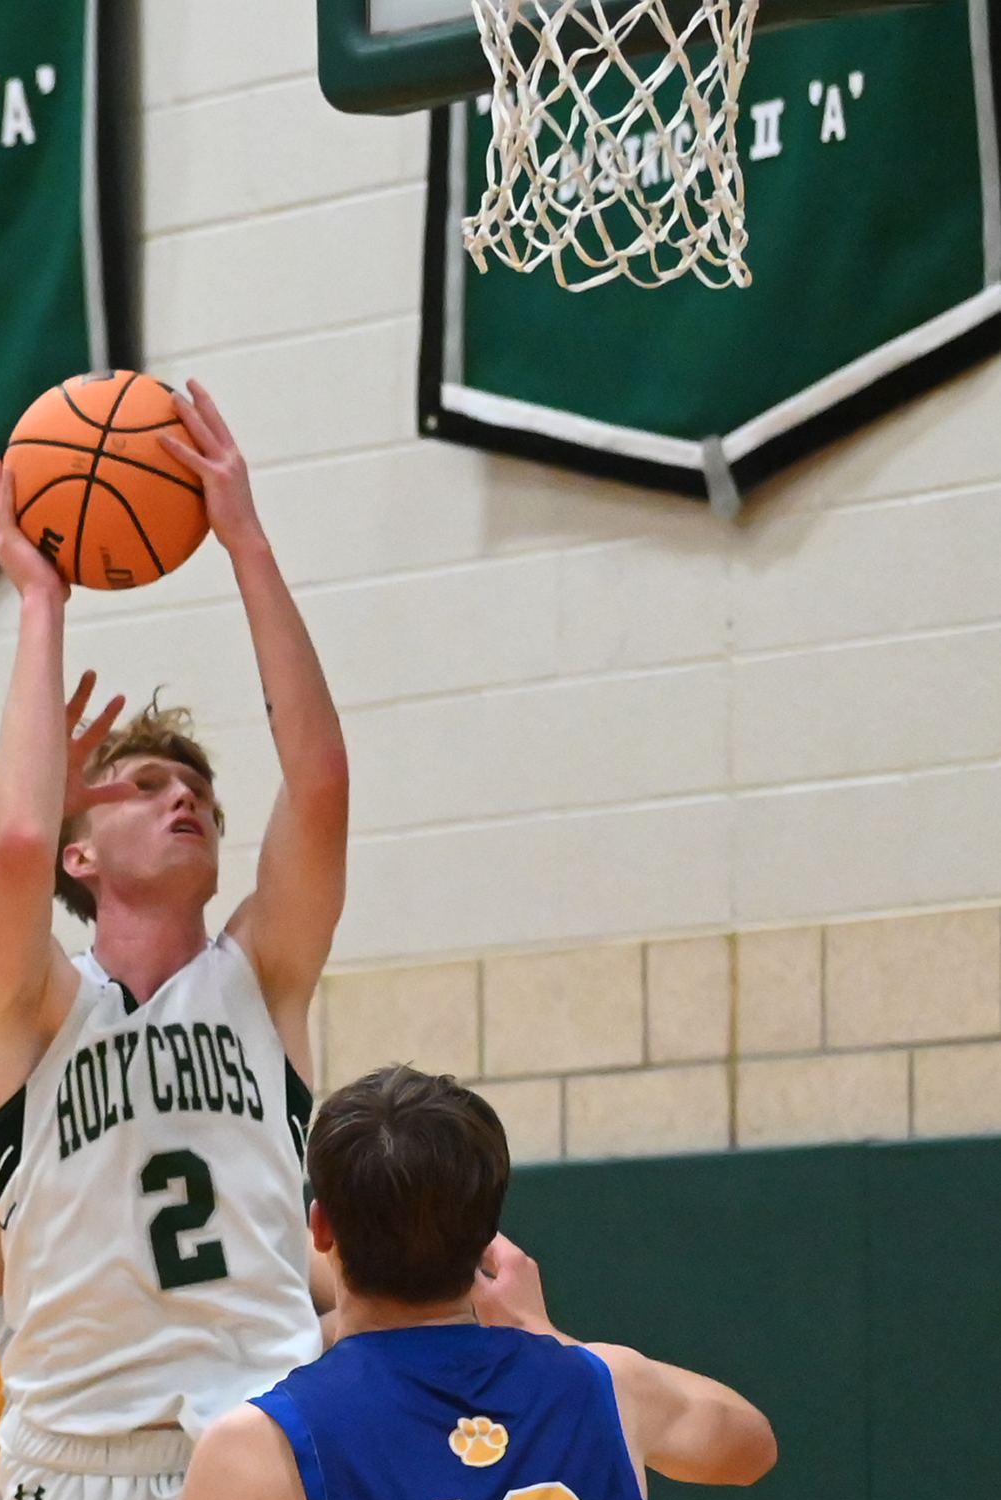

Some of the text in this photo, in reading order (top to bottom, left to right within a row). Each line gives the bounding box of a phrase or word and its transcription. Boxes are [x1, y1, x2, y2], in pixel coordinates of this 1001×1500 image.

[749, 97, 785, 162] II
[57, 1022, 264, 1160] HOLY CROSS
[140, 1148, 228, 1291] 2
